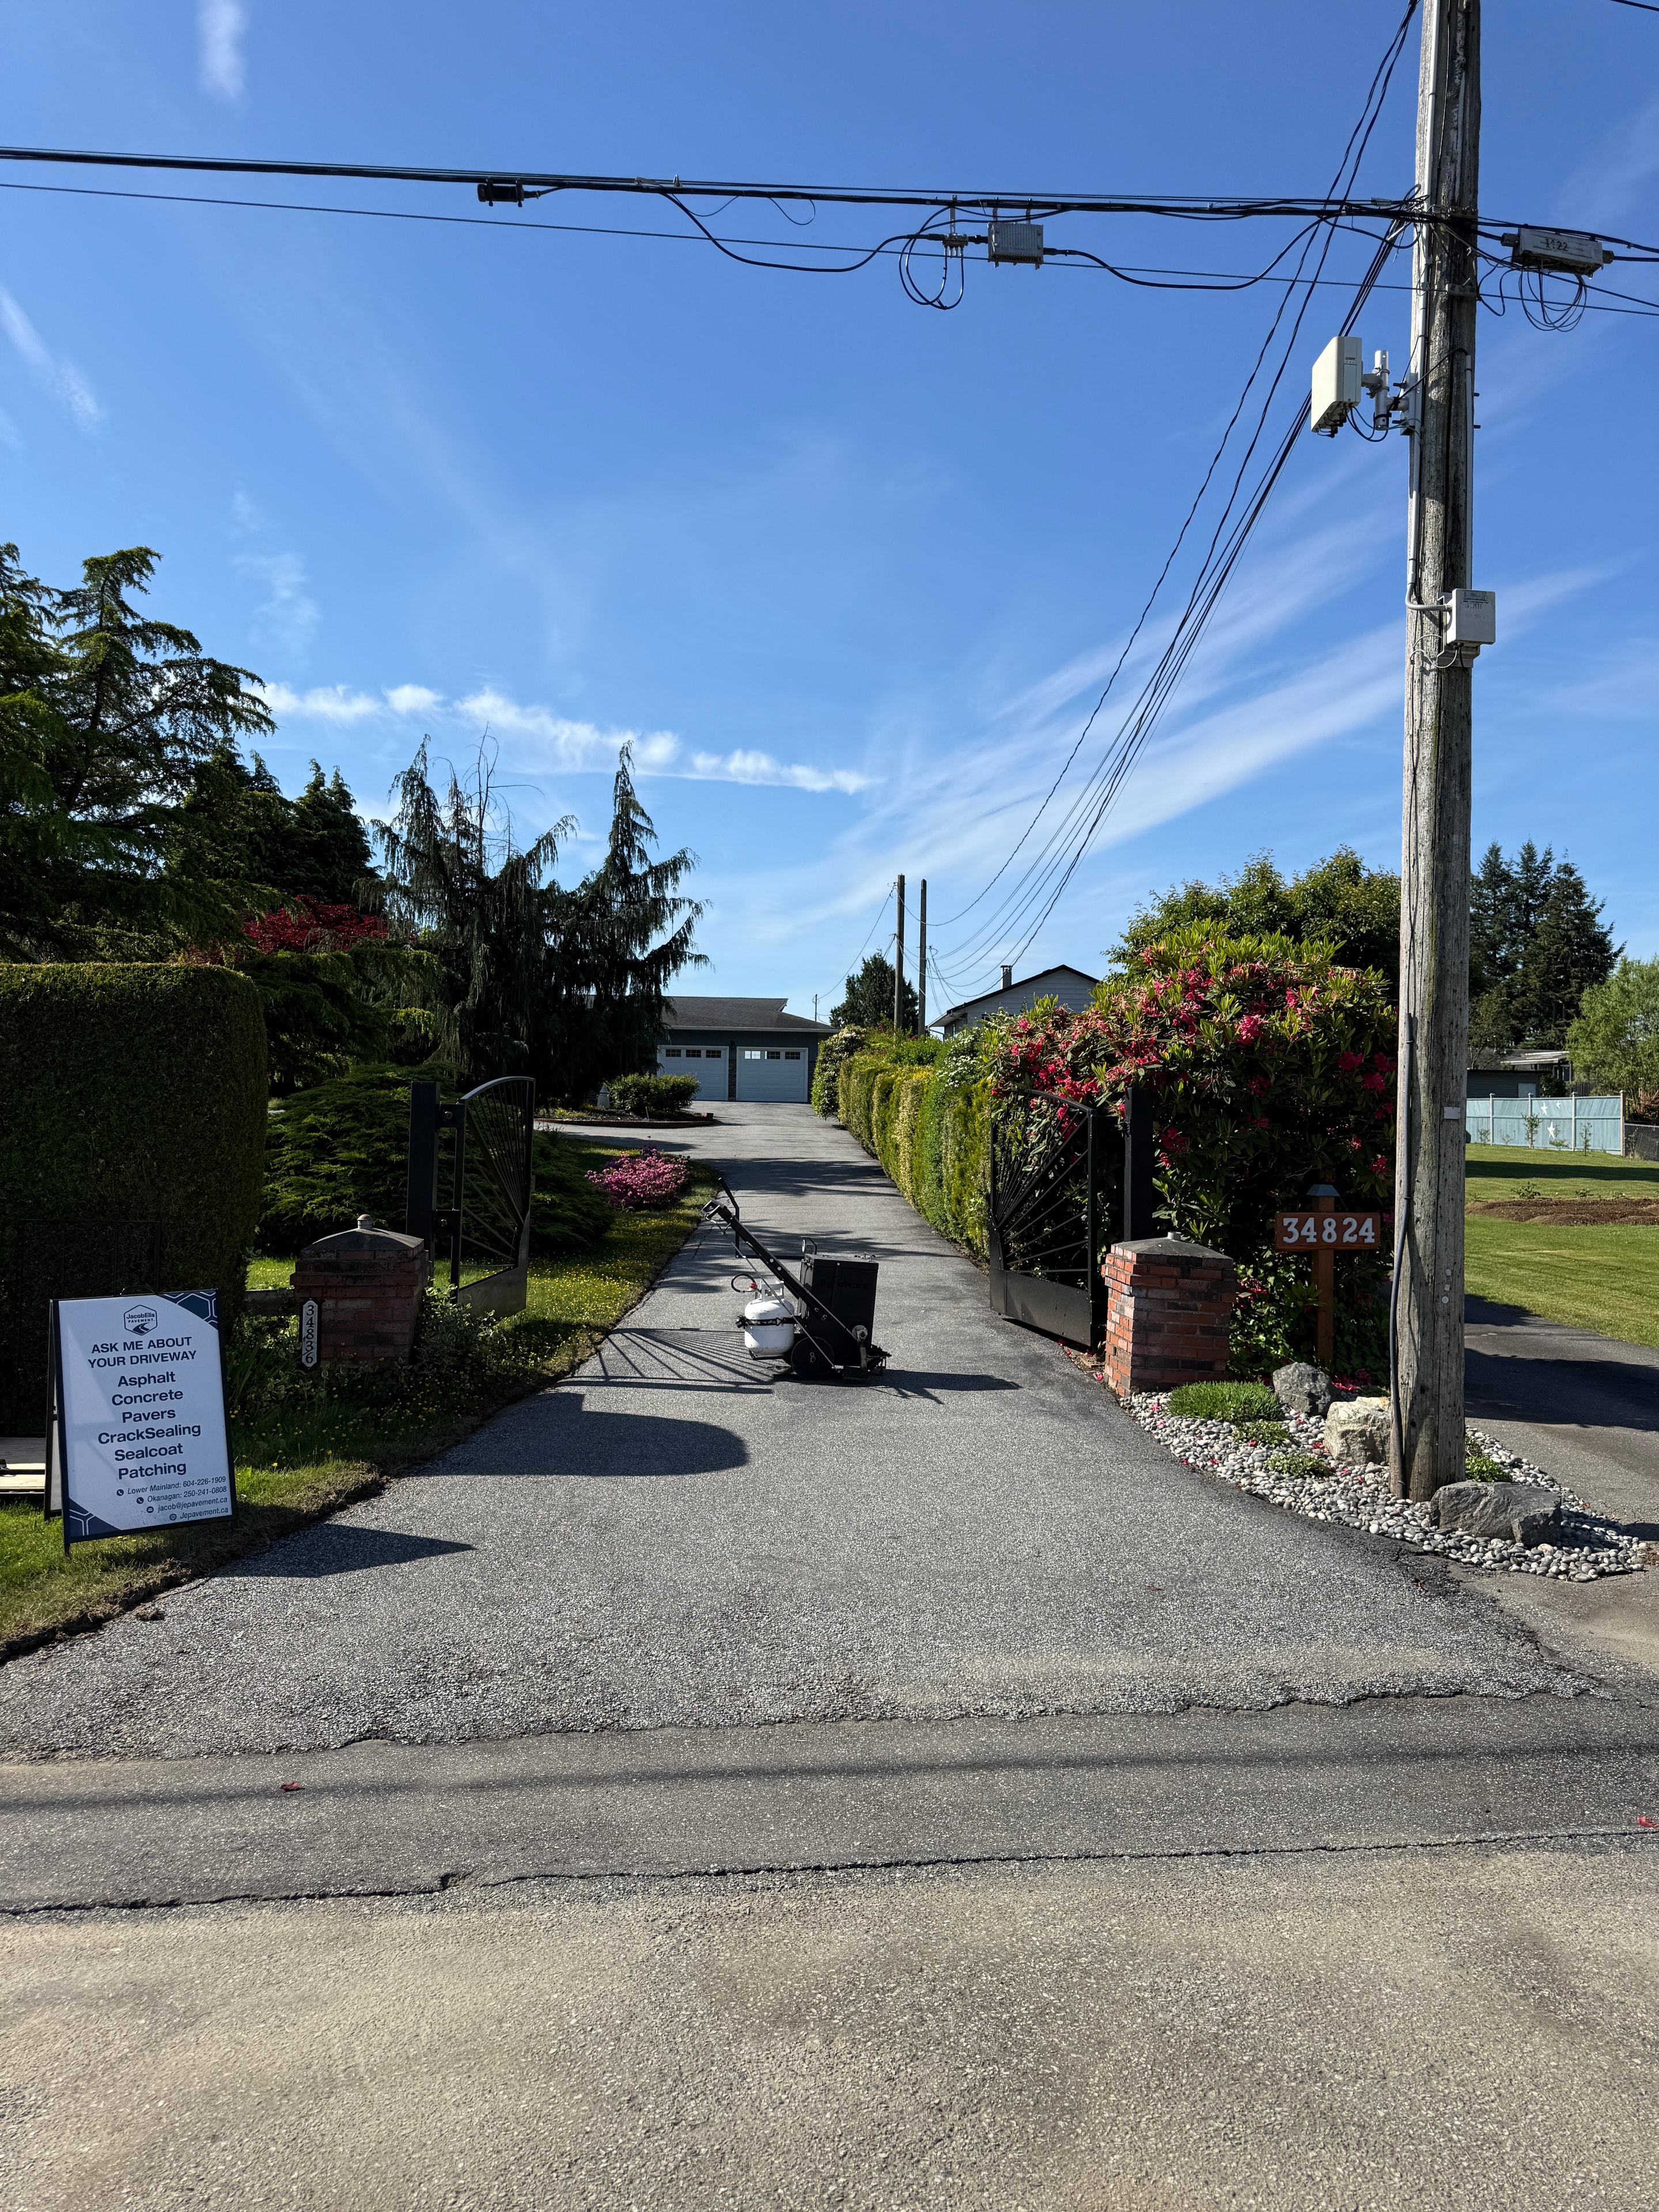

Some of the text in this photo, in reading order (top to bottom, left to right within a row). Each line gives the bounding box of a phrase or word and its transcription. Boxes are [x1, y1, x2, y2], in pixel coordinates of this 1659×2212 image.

[1283, 1217, 1375, 1244] 34824
[820, 1279, 868, 1289] RyoWorx
[305, 1305, 315, 1363] 34836
[91, 1336, 192, 1354] ASK ME ABOUT
[88, 1350, 196, 1368] YOUR DRIVEWAY
[118, 1372, 176, 1388] Asphalt
[112, 1389, 183, 1406] Concrete
[122, 1409, 176, 1423] Pavers
[98, 1424, 201, 1444] CrackSealing
[115, 1443, 183, 1461] Sealcoat
[118, 1463, 187, 1480] Patching
[127, 1476, 226, 1494] Lower Mainland: 604-226-1909
[147, 1486, 227, 1502] Okanagan: 250-241-0808
[157, 1497, 228, 1513] jacob@jepavement.ca
[180, 1507, 228, 1520] Jepavement.ca
